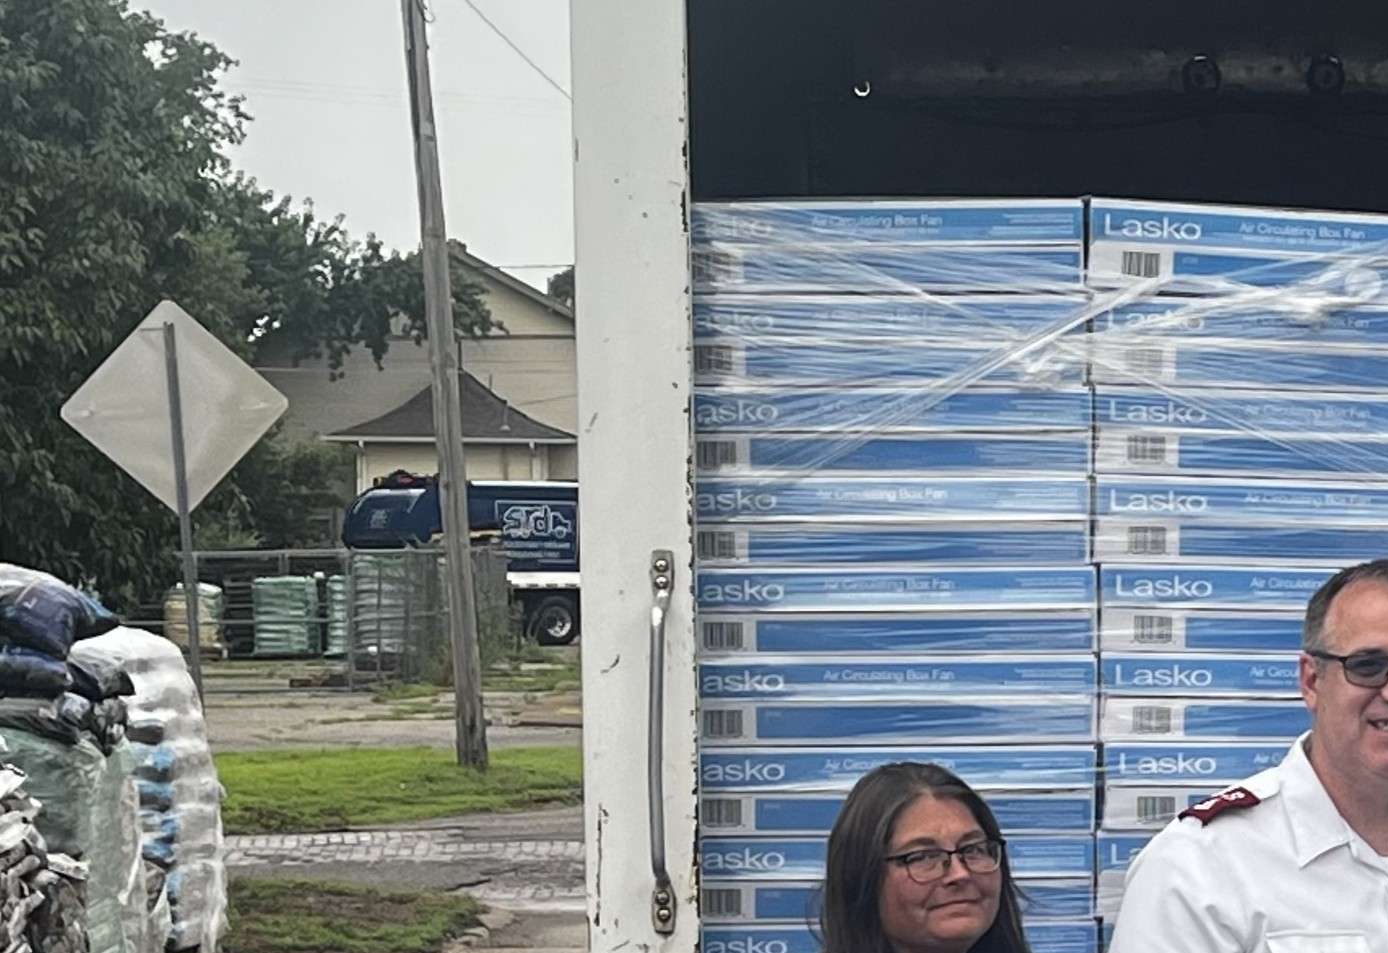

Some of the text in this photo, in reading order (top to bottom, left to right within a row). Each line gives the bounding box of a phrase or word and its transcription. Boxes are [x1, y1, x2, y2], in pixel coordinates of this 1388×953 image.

[1104, 213, 1202, 241] Lasko
[1318, 225, 1341, 238] Box
[1343, 227, 1366, 239] Fan
[697, 400, 779, 422] asko
[1109, 399, 1208, 424] Lasko
[697, 488, 778, 511] asko
[1109, 489, 1208, 513] Lasko
[701, 579, 785, 602] asko
[1115, 575, 1213, 598] Lasko
[1249, 577, 1323, 590] Air Circulatin
[702, 669, 785, 692] asko
[1115, 664, 1213, 688] Lasko
[703, 760, 787, 782] asko
[1119, 752, 1217, 776] Lasko
[702, 848, 786, 871] asko
